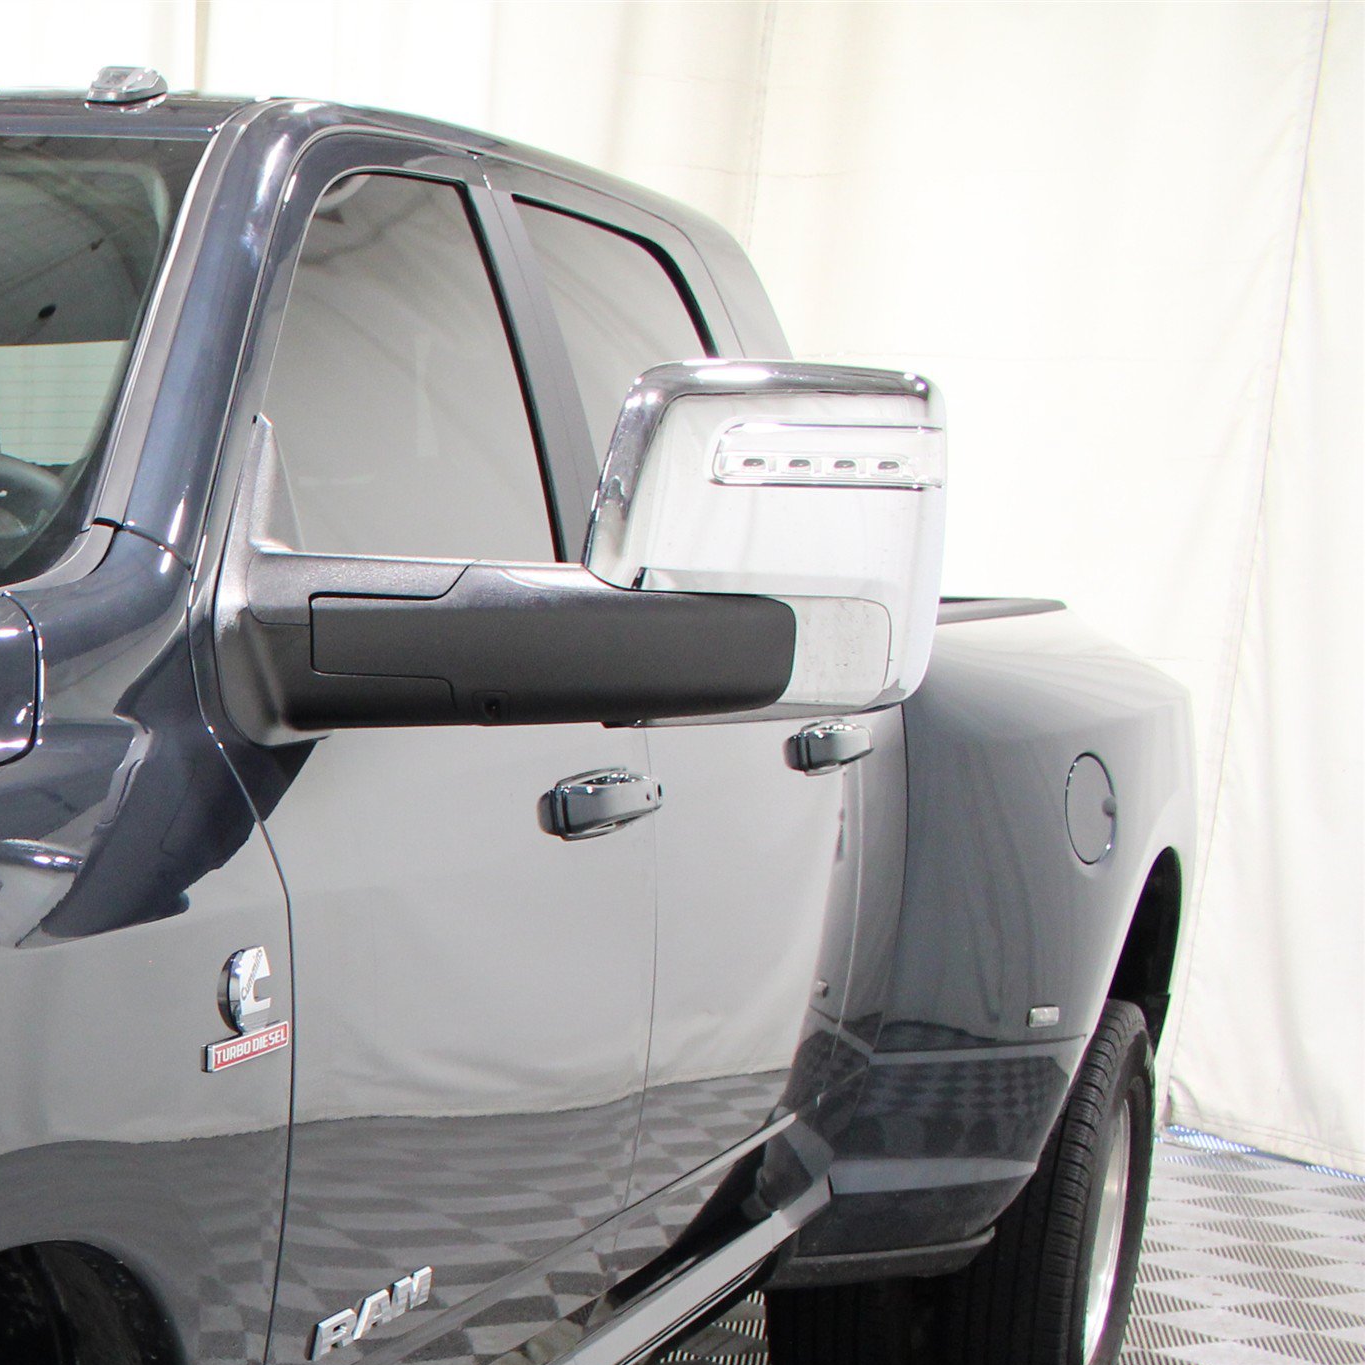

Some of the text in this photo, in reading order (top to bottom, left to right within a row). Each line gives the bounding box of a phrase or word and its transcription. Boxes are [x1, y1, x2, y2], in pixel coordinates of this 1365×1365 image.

[215, 1028, 287, 1065] TURBO DIESEL
[306, 1265, 434, 1362] RAM
